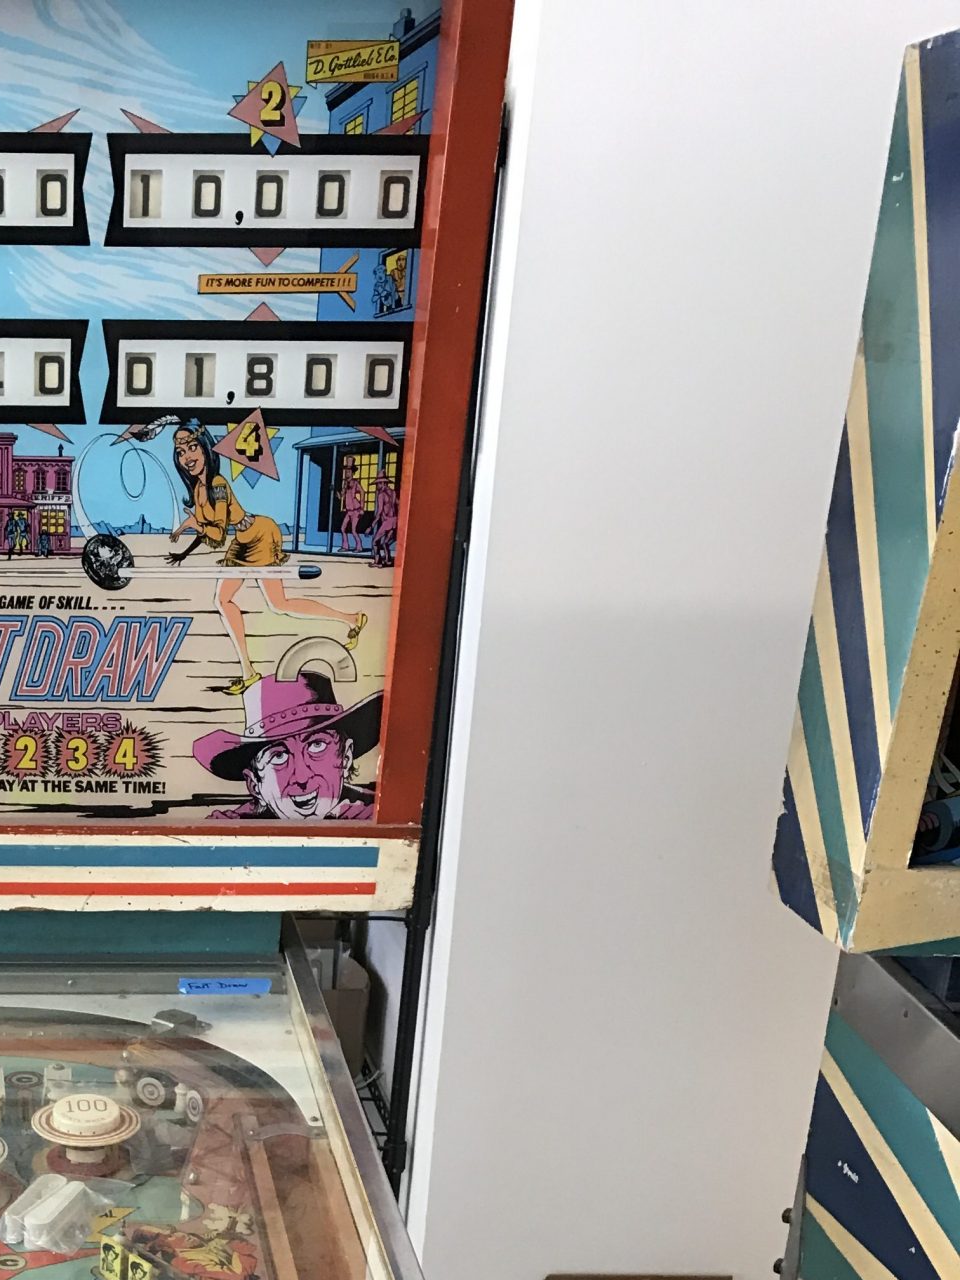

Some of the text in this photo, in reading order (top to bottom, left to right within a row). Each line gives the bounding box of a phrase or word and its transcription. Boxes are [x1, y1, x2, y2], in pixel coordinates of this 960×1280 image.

[328, 49, 375, 75] Gottlieb
[259, 81, 285, 127] 2
[205, 277, 223, 288] IT'S
[224, 277, 253, 288] MORE
[255, 277, 275, 288] FUN
[277, 277, 290, 288] TO
[290, 277, 336, 288] COMPETE
[234, 421, 262, 463] 4
[38, 596, 56, 609] OF
[9, 616, 194, 702] DRAW
[14, 735, 38, 771] 2
[66, 737, 89, 772] 3
[113, 737, 138, 772] 4
[19, 779, 40, 793] AT
[42, 780, 72, 793] THE
[74, 780, 118, 793] SAME
[122, 781, 167, 794] TIME!
[65, 1099, 108, 1113] 100
